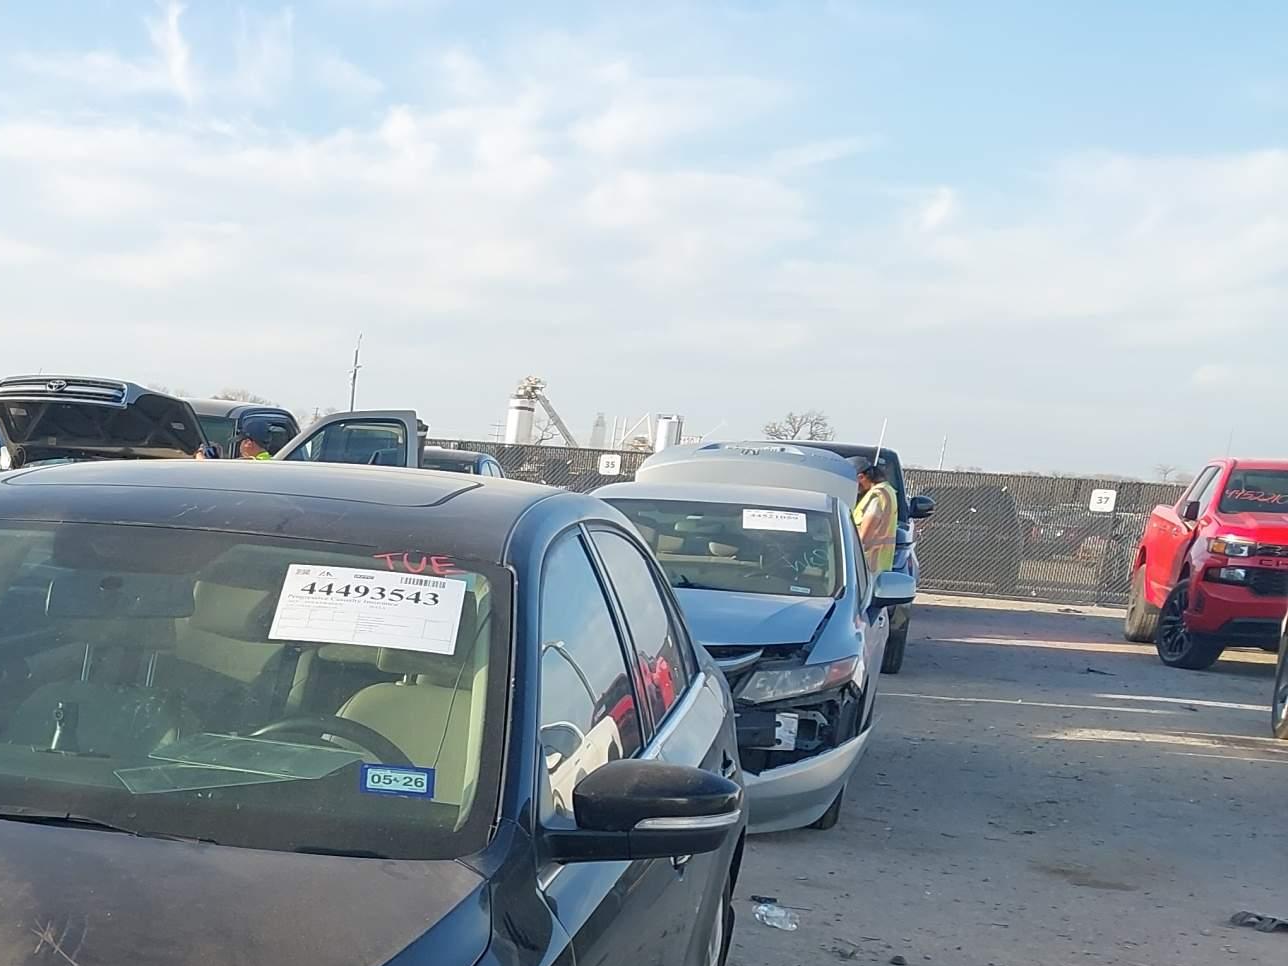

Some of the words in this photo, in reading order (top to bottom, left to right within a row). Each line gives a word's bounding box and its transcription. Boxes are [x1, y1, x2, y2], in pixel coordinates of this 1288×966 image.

[1096, 496, 1110, 504] 37
[373, 552, 467, 575] TUE
[300, 581, 440, 607] 44493543
